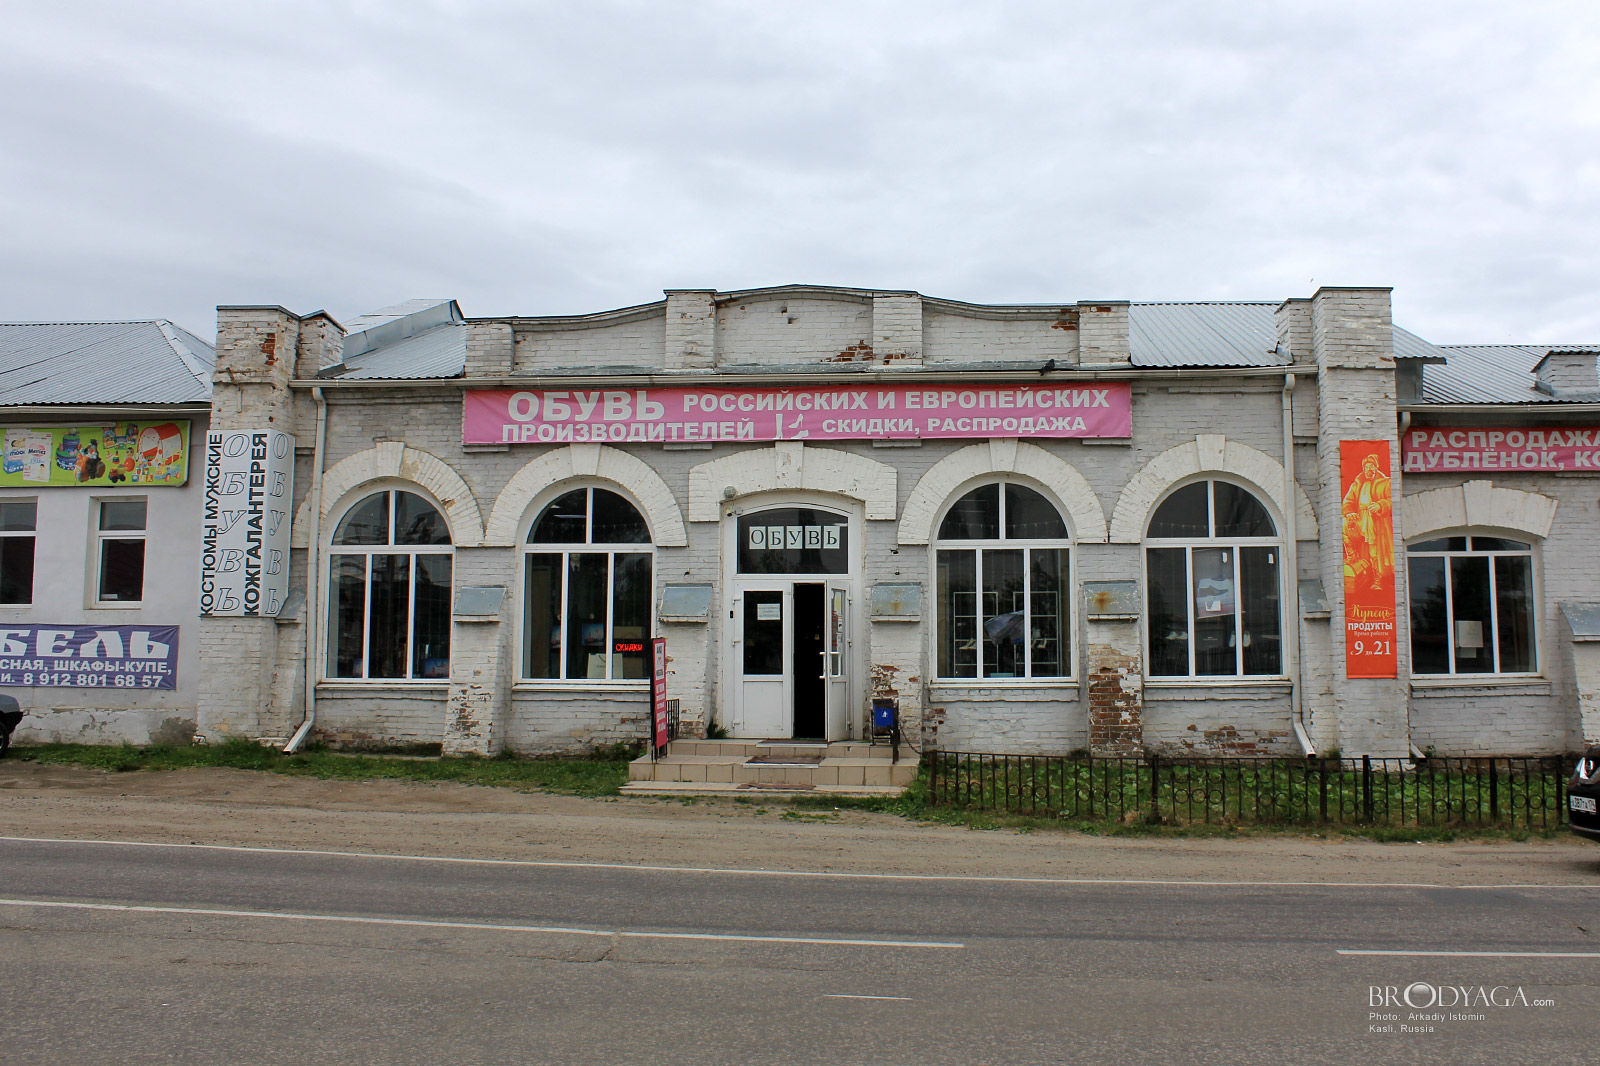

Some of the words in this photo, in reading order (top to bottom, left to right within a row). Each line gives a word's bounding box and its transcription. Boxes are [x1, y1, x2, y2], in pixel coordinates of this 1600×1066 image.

[507, 390, 665, 422] ОБУВЬ
[683, 389, 869, 412] РОССИЙСКИХ
[877, 391, 896, 410] И
[905, 386, 1110, 409] ЕВРОПЕЙСКИХ
[502, 417, 755, 442] ПРОИЗВОДИТЕЛЕЙ
[822, 417, 920, 434] СКИДКИ,
[927, 415, 1087, 433] РАСПРОДАЖА
[1404, 448, 1565, 472] ДУБЛЁНОК,
[205, 433, 223, 520] МУЖСКИЕ
[214, 433, 250, 612] ОБУВЬ
[244, 433, 267, 616] КОЖГАЛАНТЕРЕЯ
[265, 433, 289, 615] ОБУВЬ
[751, 529, 838, 546] ОБУВЬ
[200, 524, 217, 616] КОСТЮМЫ
[1347, 622, 1393, 631] ПРОДУКТЫ
[0, 629, 170, 659] БЕЛЬ
[1354, 640, 1364, 656] 9
[1373, 640, 1391, 655] 21
[0, 659, 49, 673] СНАЯ,
[53, 660, 172, 675] ШКАФЫ-КУПЕ,
[23, 673, 34, 685] 8
[39, 673, 71, 686] 912
[76, 674, 107, 687] 801
[114, 675, 136, 687] 68
[141, 675, 163, 688] 57
